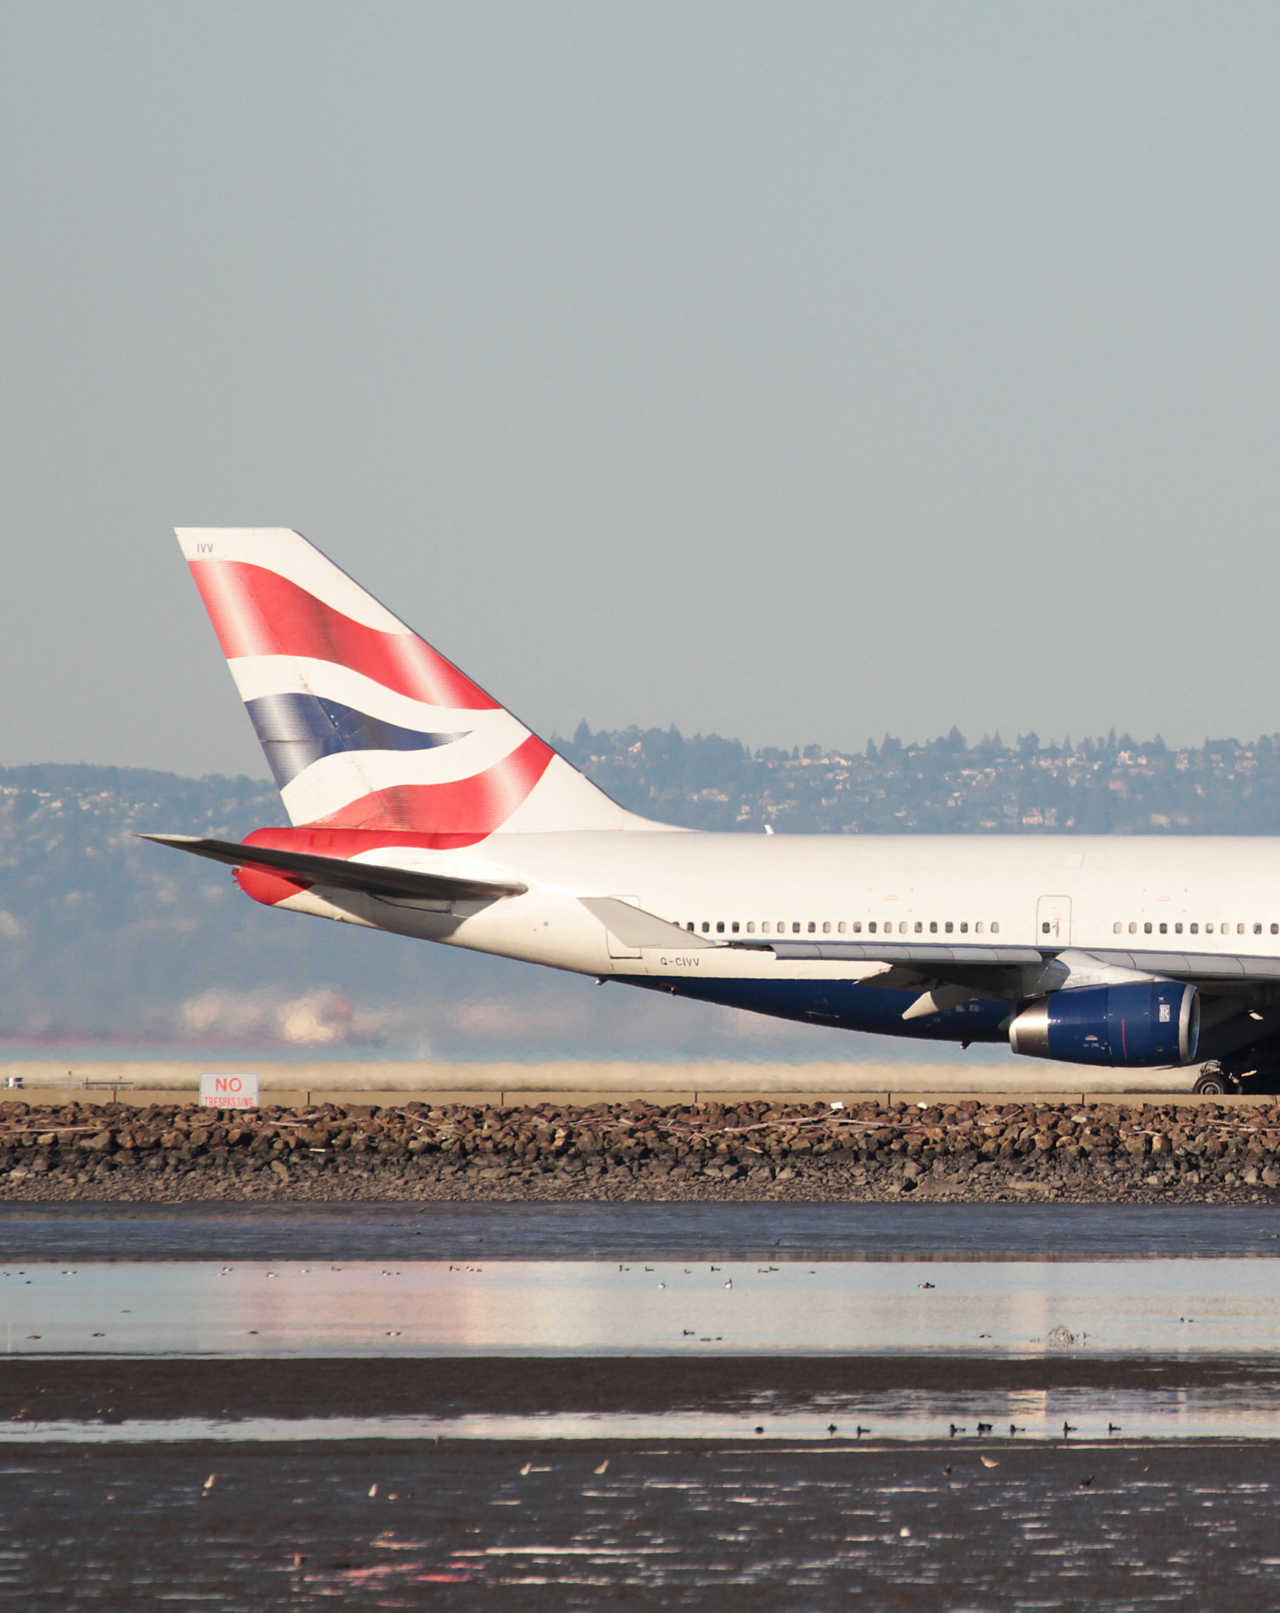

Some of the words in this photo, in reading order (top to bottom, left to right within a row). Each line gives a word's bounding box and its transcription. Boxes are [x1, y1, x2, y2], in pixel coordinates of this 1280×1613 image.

[197, 543, 214, 553] IVV
[660, 956, 700, 967] G-CIVV
[216, 1077, 242, 1092] NO
